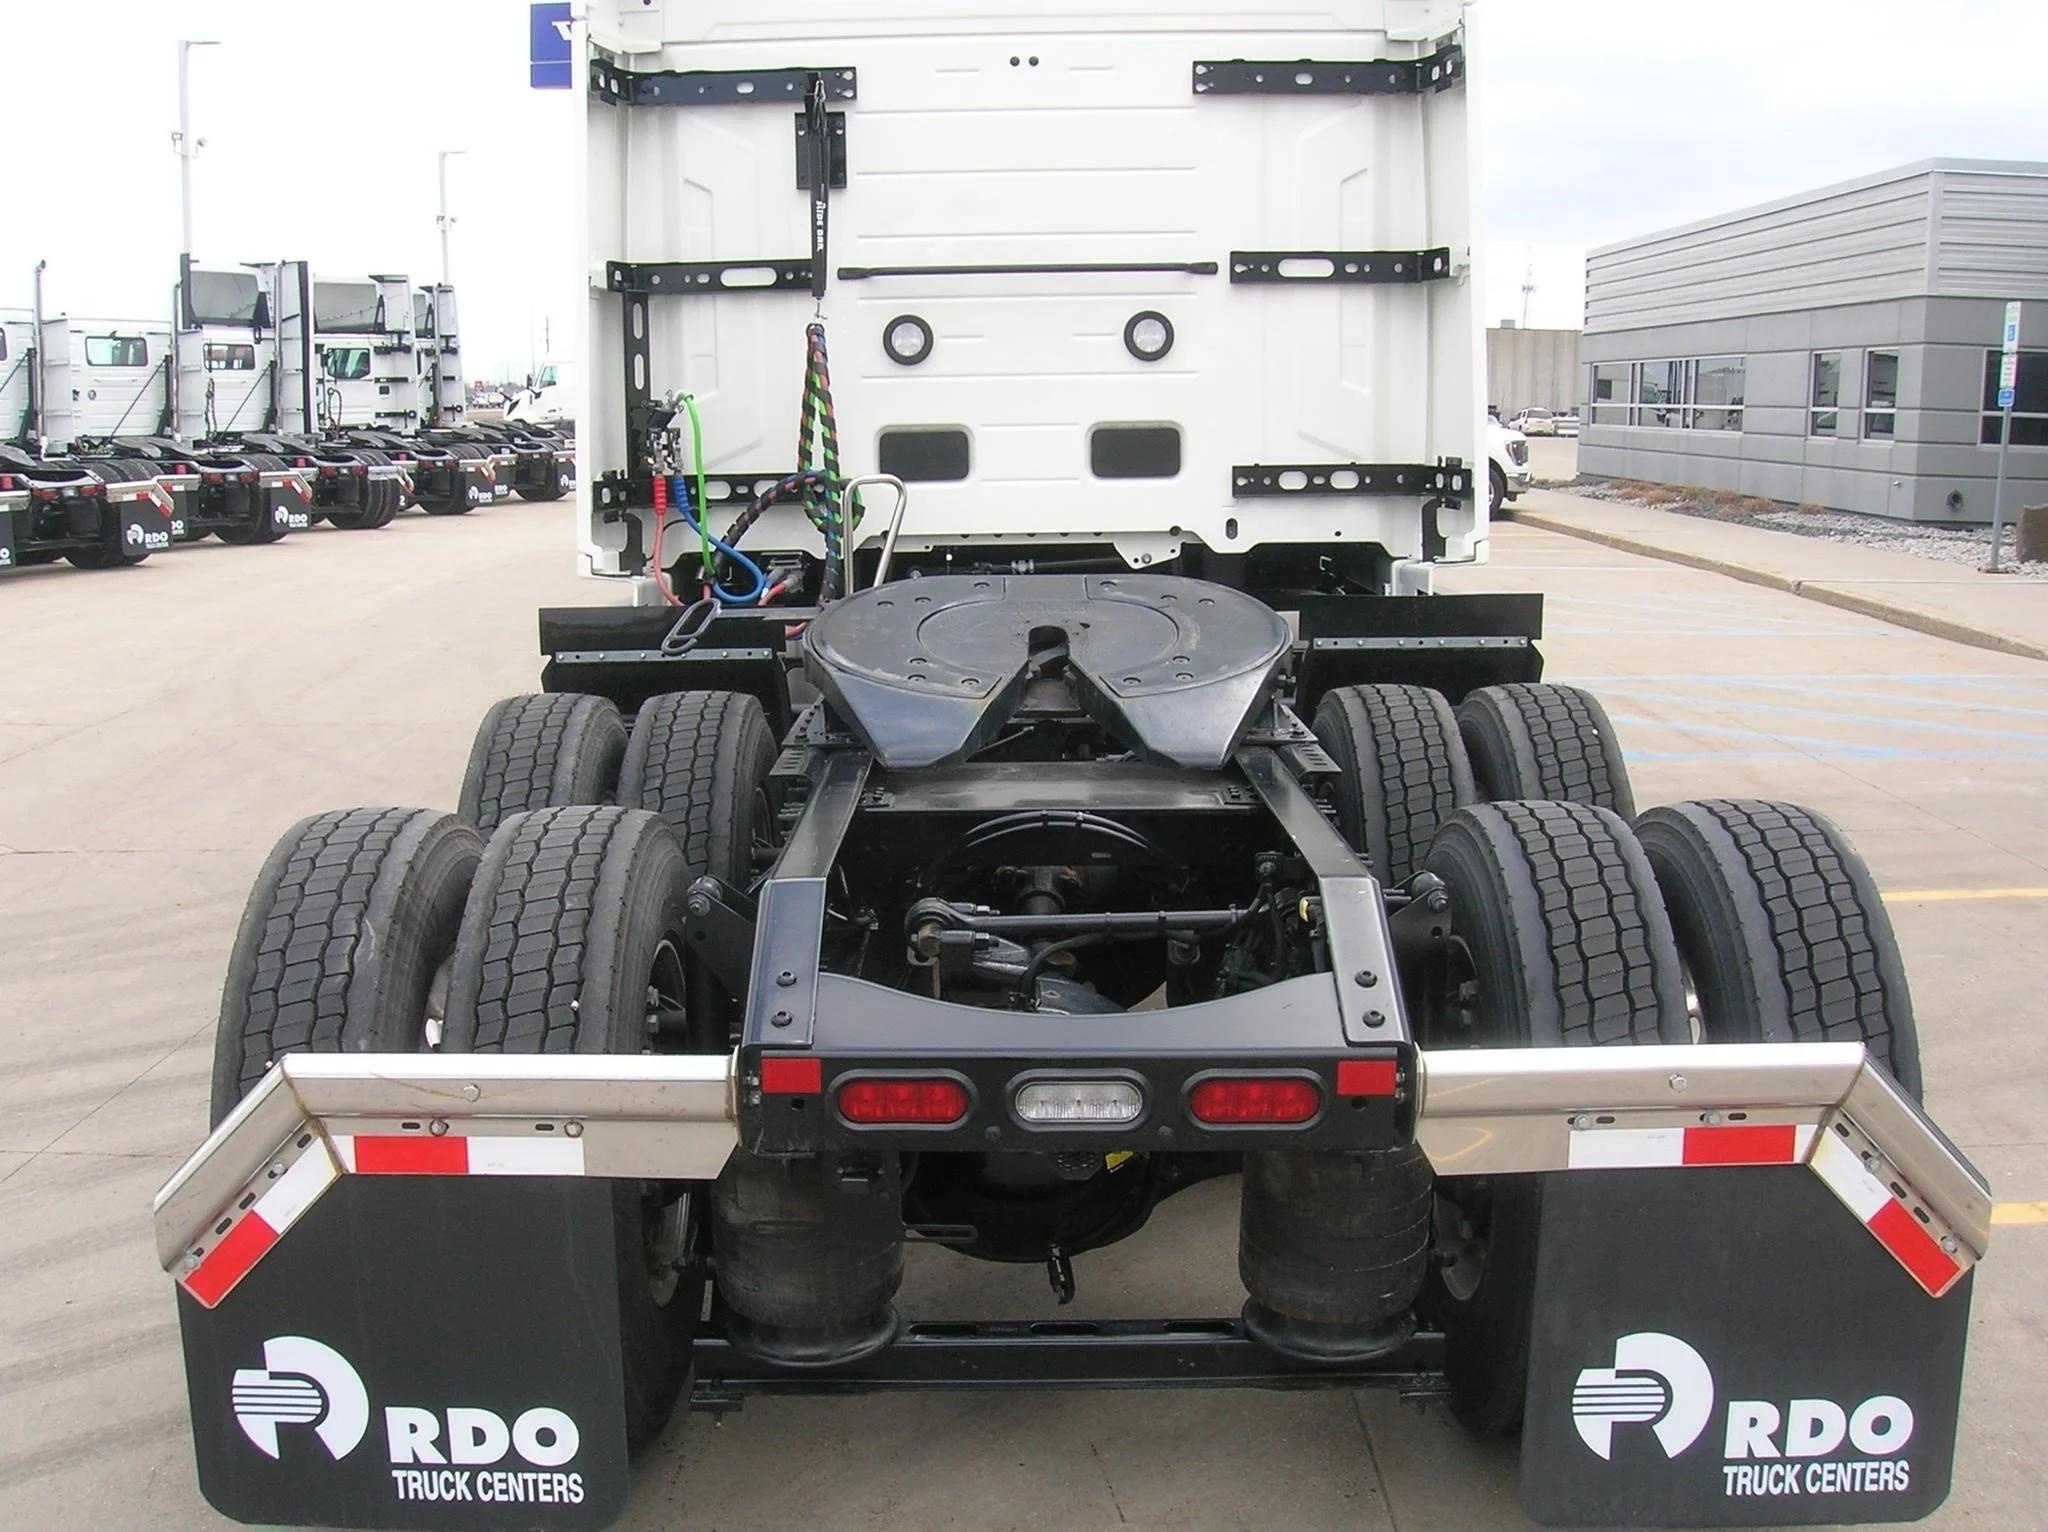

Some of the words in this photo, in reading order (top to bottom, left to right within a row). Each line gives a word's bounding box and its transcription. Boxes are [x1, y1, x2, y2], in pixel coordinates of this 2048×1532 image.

[289, 514, 307, 522] RDO
[145, 532, 168, 543] RDO
[385, 1407, 580, 1466] RDO
[1724, 1395, 1914, 1458] RDO
[392, 1470, 472, 1501] TRUCK
[476, 1471, 585, 1504] CENTERS
[1723, 1463, 1801, 1496] TRUCK
[1805, 1460, 1910, 1494] CENTERS
